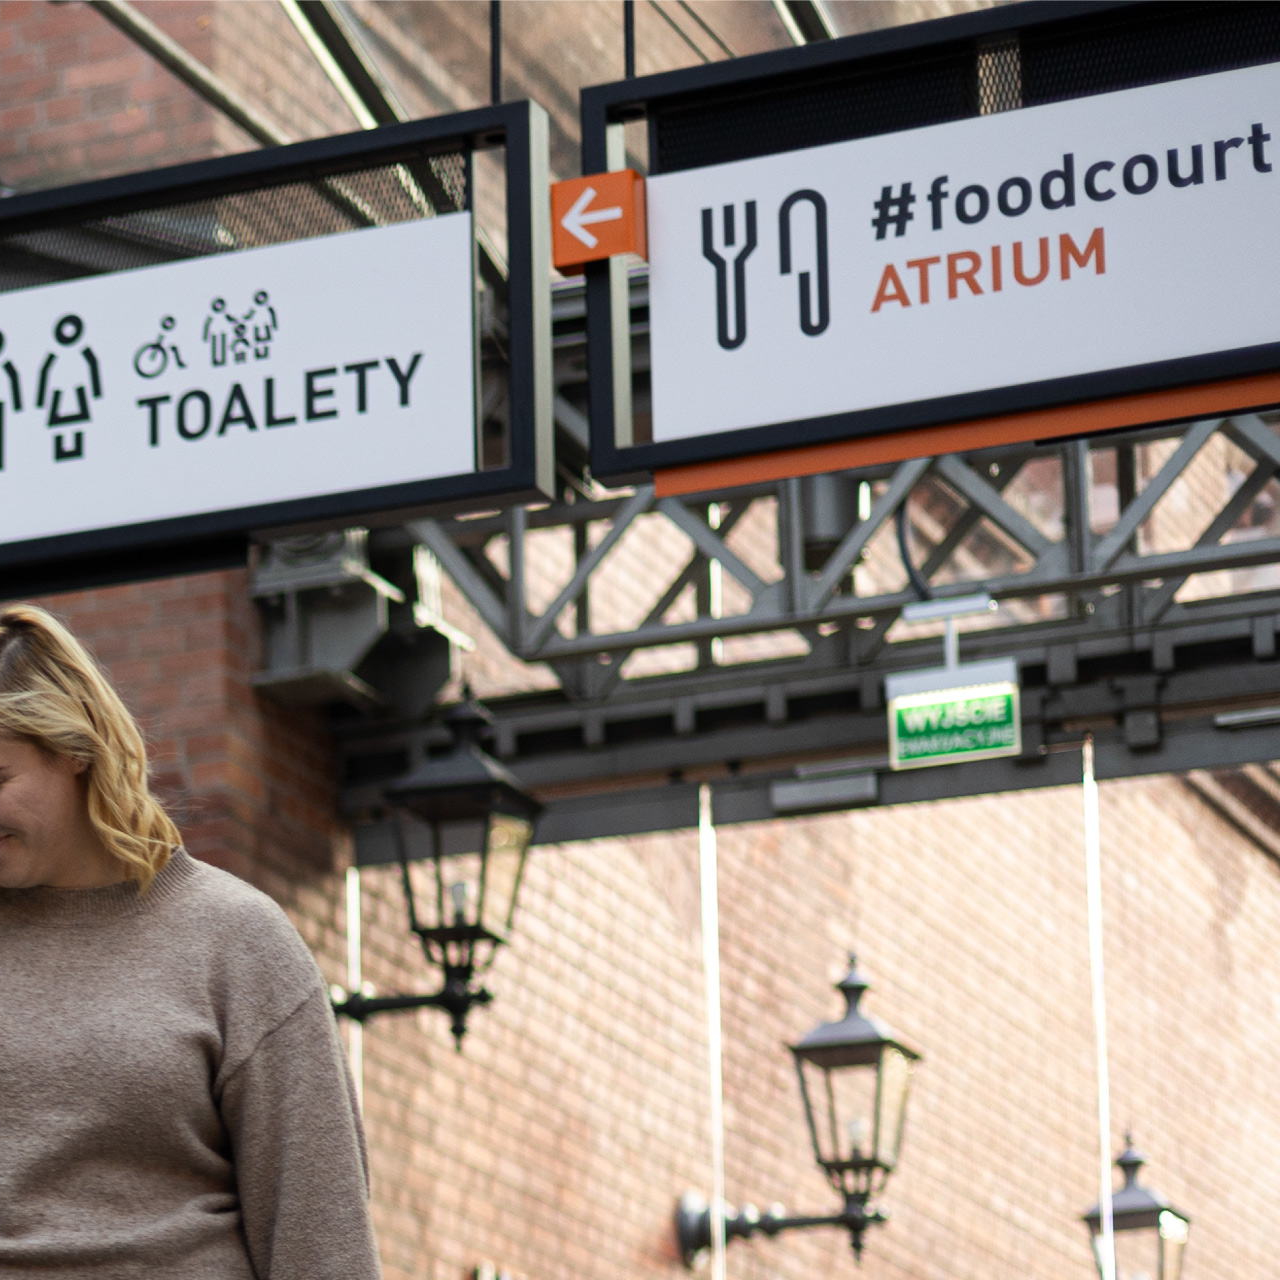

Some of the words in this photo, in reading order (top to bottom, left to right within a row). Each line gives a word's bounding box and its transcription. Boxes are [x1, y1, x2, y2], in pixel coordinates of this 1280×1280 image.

[872, 123, 1272, 240] #foodcourt
[871, 227, 1106, 313] ATRIUM
[138, 354, 423, 446] TOALETY
